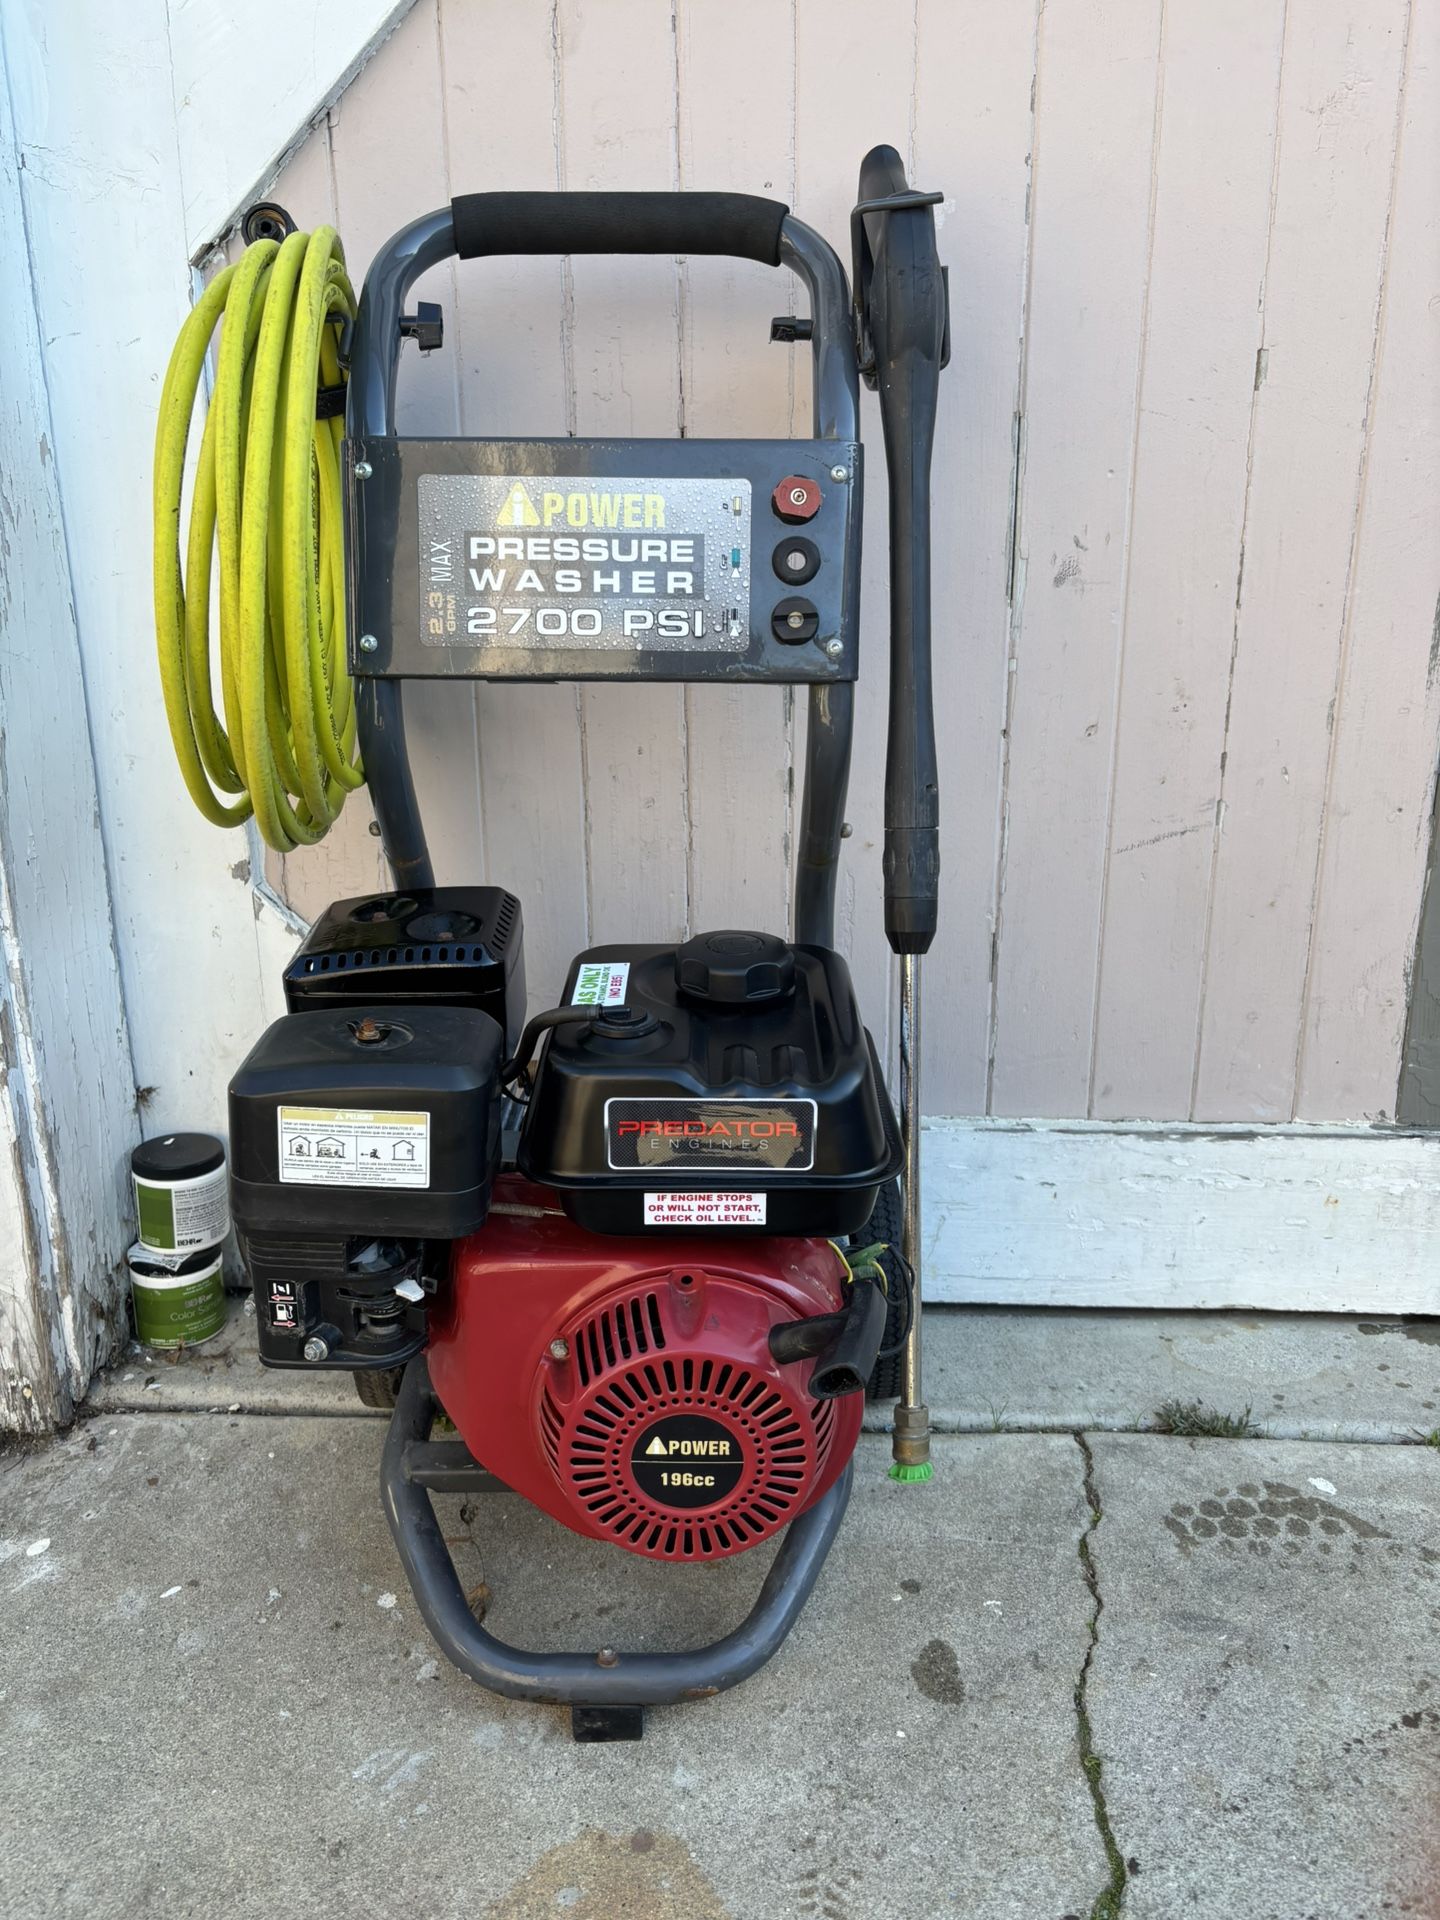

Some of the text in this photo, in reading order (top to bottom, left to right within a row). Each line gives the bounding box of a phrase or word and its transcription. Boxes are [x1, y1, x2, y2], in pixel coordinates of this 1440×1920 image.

[543, 491, 666, 529] POWER
[469, 536, 695, 563] PRESSURE
[430, 540, 452, 582] MAX
[468, 568, 694, 594] WASHER
[466, 607, 602, 636] 2700
[622, 609, 703, 638] PSI
[576, 966, 602, 1004] AS ONLY
[617, 1120, 799, 1138] PREDATOR
[650, 1138, 770, 1150] ENGINES
[656, 1194, 753, 1202] IF ENGINE STOPS
[647, 1204, 761, 1213] OR WILL NOT START,
[653, 1214, 693, 1222] CHECK
[695, 1214, 715, 1222] OIL
[717, 1214, 756, 1222] LEVEL.
[668, 1439, 731, 1456] POWER
[660, 1472, 716, 1487] 196cc
